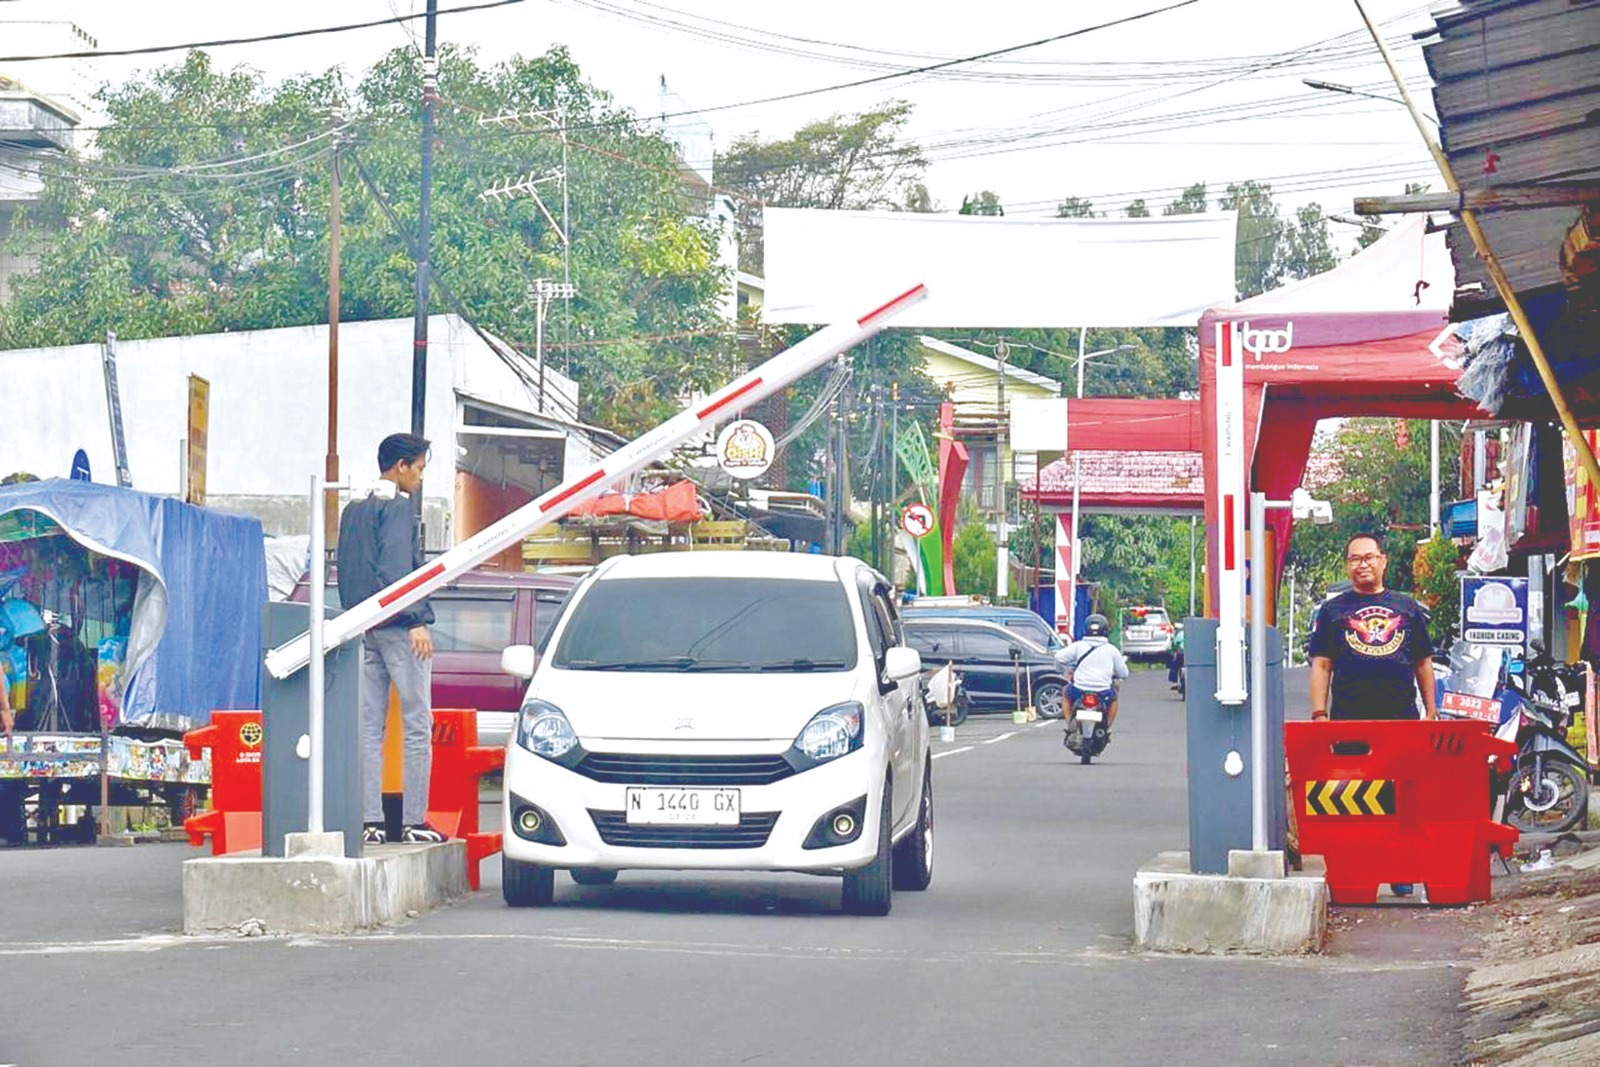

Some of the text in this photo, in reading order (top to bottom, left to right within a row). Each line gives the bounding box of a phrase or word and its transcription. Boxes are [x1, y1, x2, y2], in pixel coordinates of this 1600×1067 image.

[1469, 631, 1520, 640] FASHION CASING
[632, 793, 735, 811] N 1440 GX
